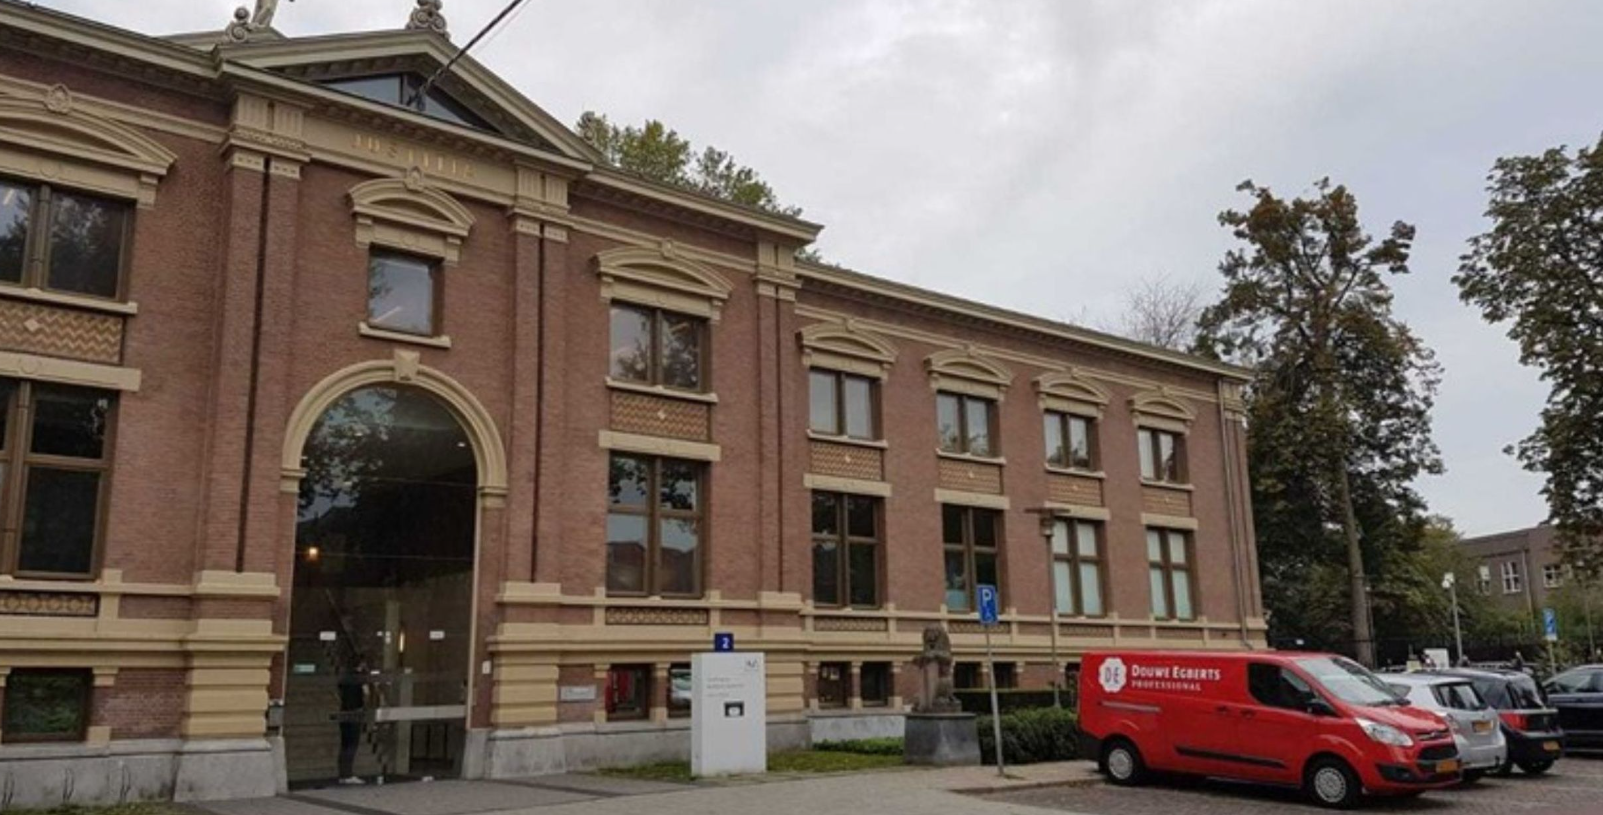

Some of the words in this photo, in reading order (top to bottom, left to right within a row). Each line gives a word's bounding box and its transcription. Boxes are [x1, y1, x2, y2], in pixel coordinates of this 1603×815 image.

[982, 589, 992, 606] P
[722, 637, 730, 649] 2
[1132, 665, 1170, 678] DOUWE
[1173, 666, 1221, 680] EGBERTS
[1131, 680, 1201, 691] PROFESSIONAL
